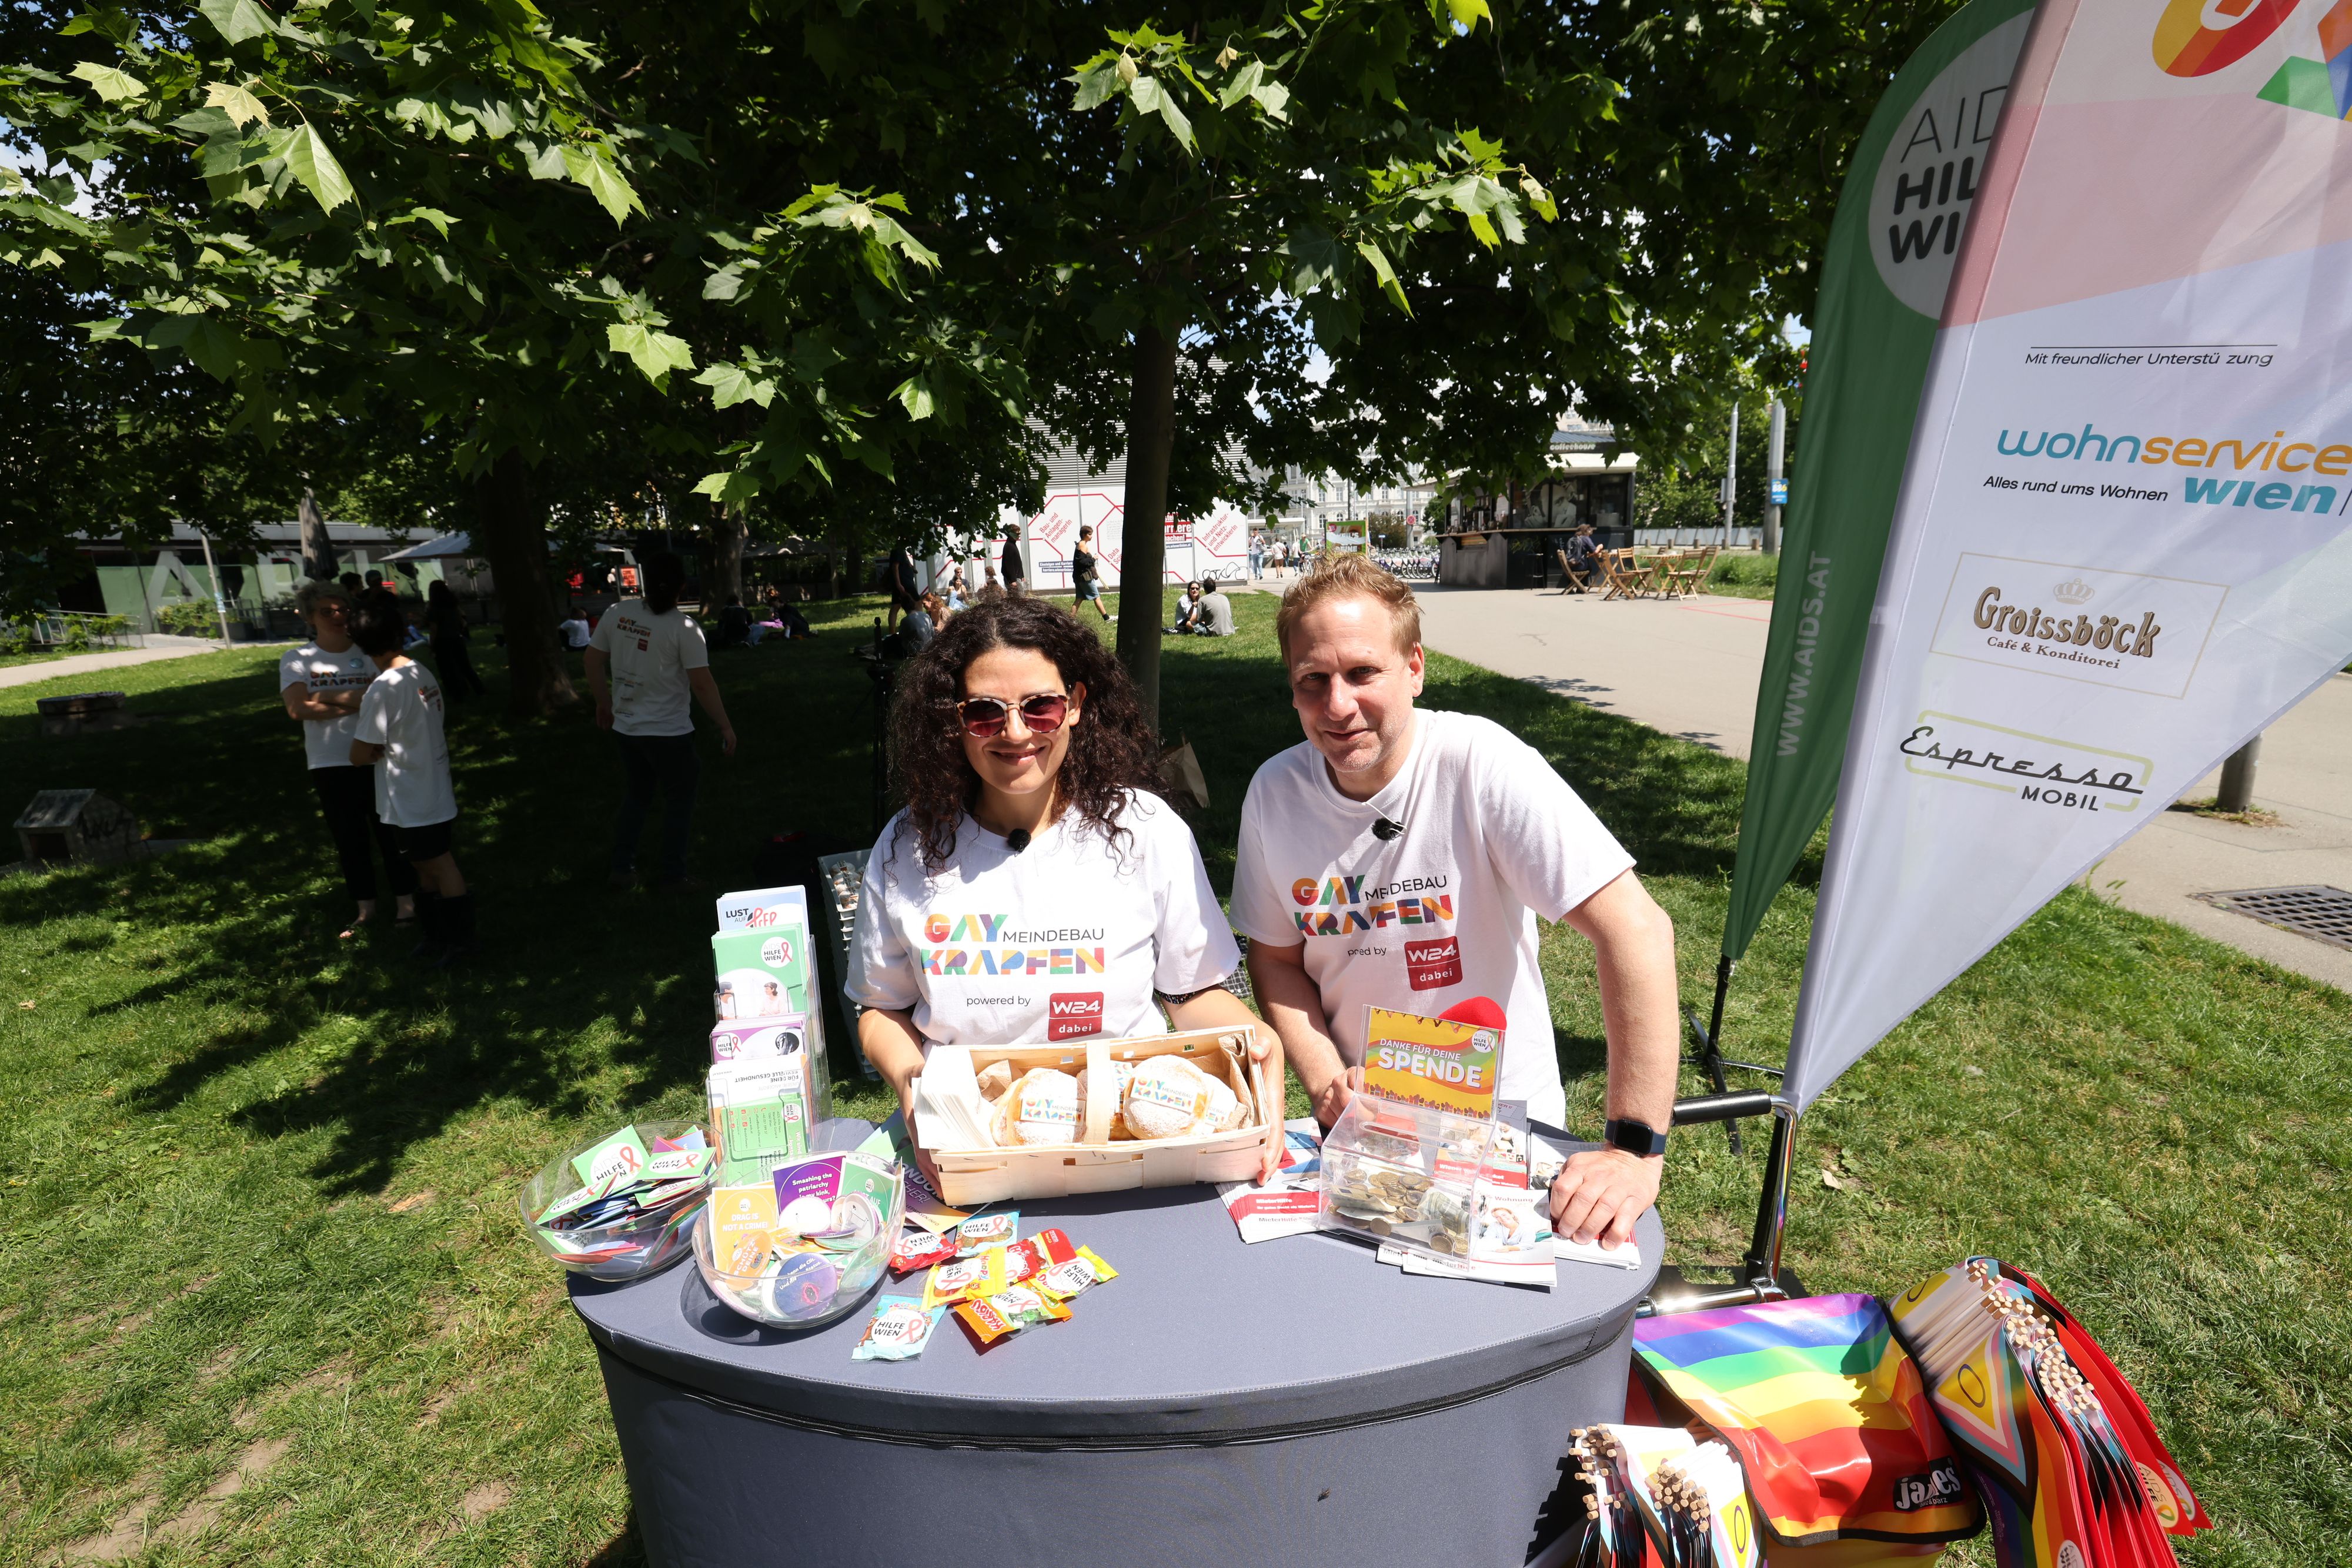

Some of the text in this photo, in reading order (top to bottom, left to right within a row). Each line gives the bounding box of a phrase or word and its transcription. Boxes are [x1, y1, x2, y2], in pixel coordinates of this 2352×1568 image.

[1893, 156, 1978, 215] HIL
[1889, 211, 1961, 264] WI
[2024, 353, 2047, 365] Mit
[2051, 352, 2141, 366] freundlicher
[1983, 476, 2337, 515] Alles rund ums Wohnen wien
[1040, 513, 1059, 533] Bau- und
[1045, 519, 1063, 539] Anlagen-
[1202, 513, 1229, 541] Infrastruktur-
[1208, 525, 1228, 546] und Netz-
[1108, 548, 1120, 559] Data
[1973, 586, 2161, 658] Groissböck
[1776, 550, 1830, 757] WWW.AIDS.AT
[1986, 636, 2120, 670] Café & Konditorei
[1899, 726, 2144, 795] Espresso
[2021, 786, 2099, 812] MOBIL
[1291, 874, 1366, 907] GAY
[726, 908, 749, 918] LUST
[924, 913, 1105, 944] GAY MEINDEBAU
[920, 947, 1105, 975] KRAPFEN
[1374, 947, 1387, 957] by
[1407, 944, 1457, 962] W24
[1419, 968, 1454, 982] dabei
[965, 995, 1031, 1007] powered by
[1051, 1001, 1101, 1015] W24
[1058, 1023, 1092, 1035] dabei
[1379, 1038, 1461, 1062] DANKE FÜR DEINE
[1378, 1048, 1483, 1088] SPENDE
[734, 1072, 770, 1083] GESUNDHEIT
[1138, 1076, 1165, 1090] GAY
[1025, 1097, 1054, 1109] GAY
[1134, 1086, 1191, 1107] KRAPFEN
[1024, 1108, 1083, 1122] KRAPFEN
[596, 1161, 624, 1181] HILFE
[792, 1175, 821, 1186] Smashing
[798, 1182, 829, 1193] patriarchy
[823, 1195, 836, 1203] urs?
[731, 1213, 751, 1222] DRAG
[722, 1223, 738, 1232] NOT
[910, 1234, 935, 1244] WIEN
[1064, 1268, 1084, 1286] HILFE
[1071, 1265, 1091, 1281] WIEN
[779, 1279, 790, 1290] Und
[970, 1298, 1006, 1331] HARIBO
[874, 1328, 901, 1336] WIEN
[2141, 1467, 2167, 1502] AIDS
